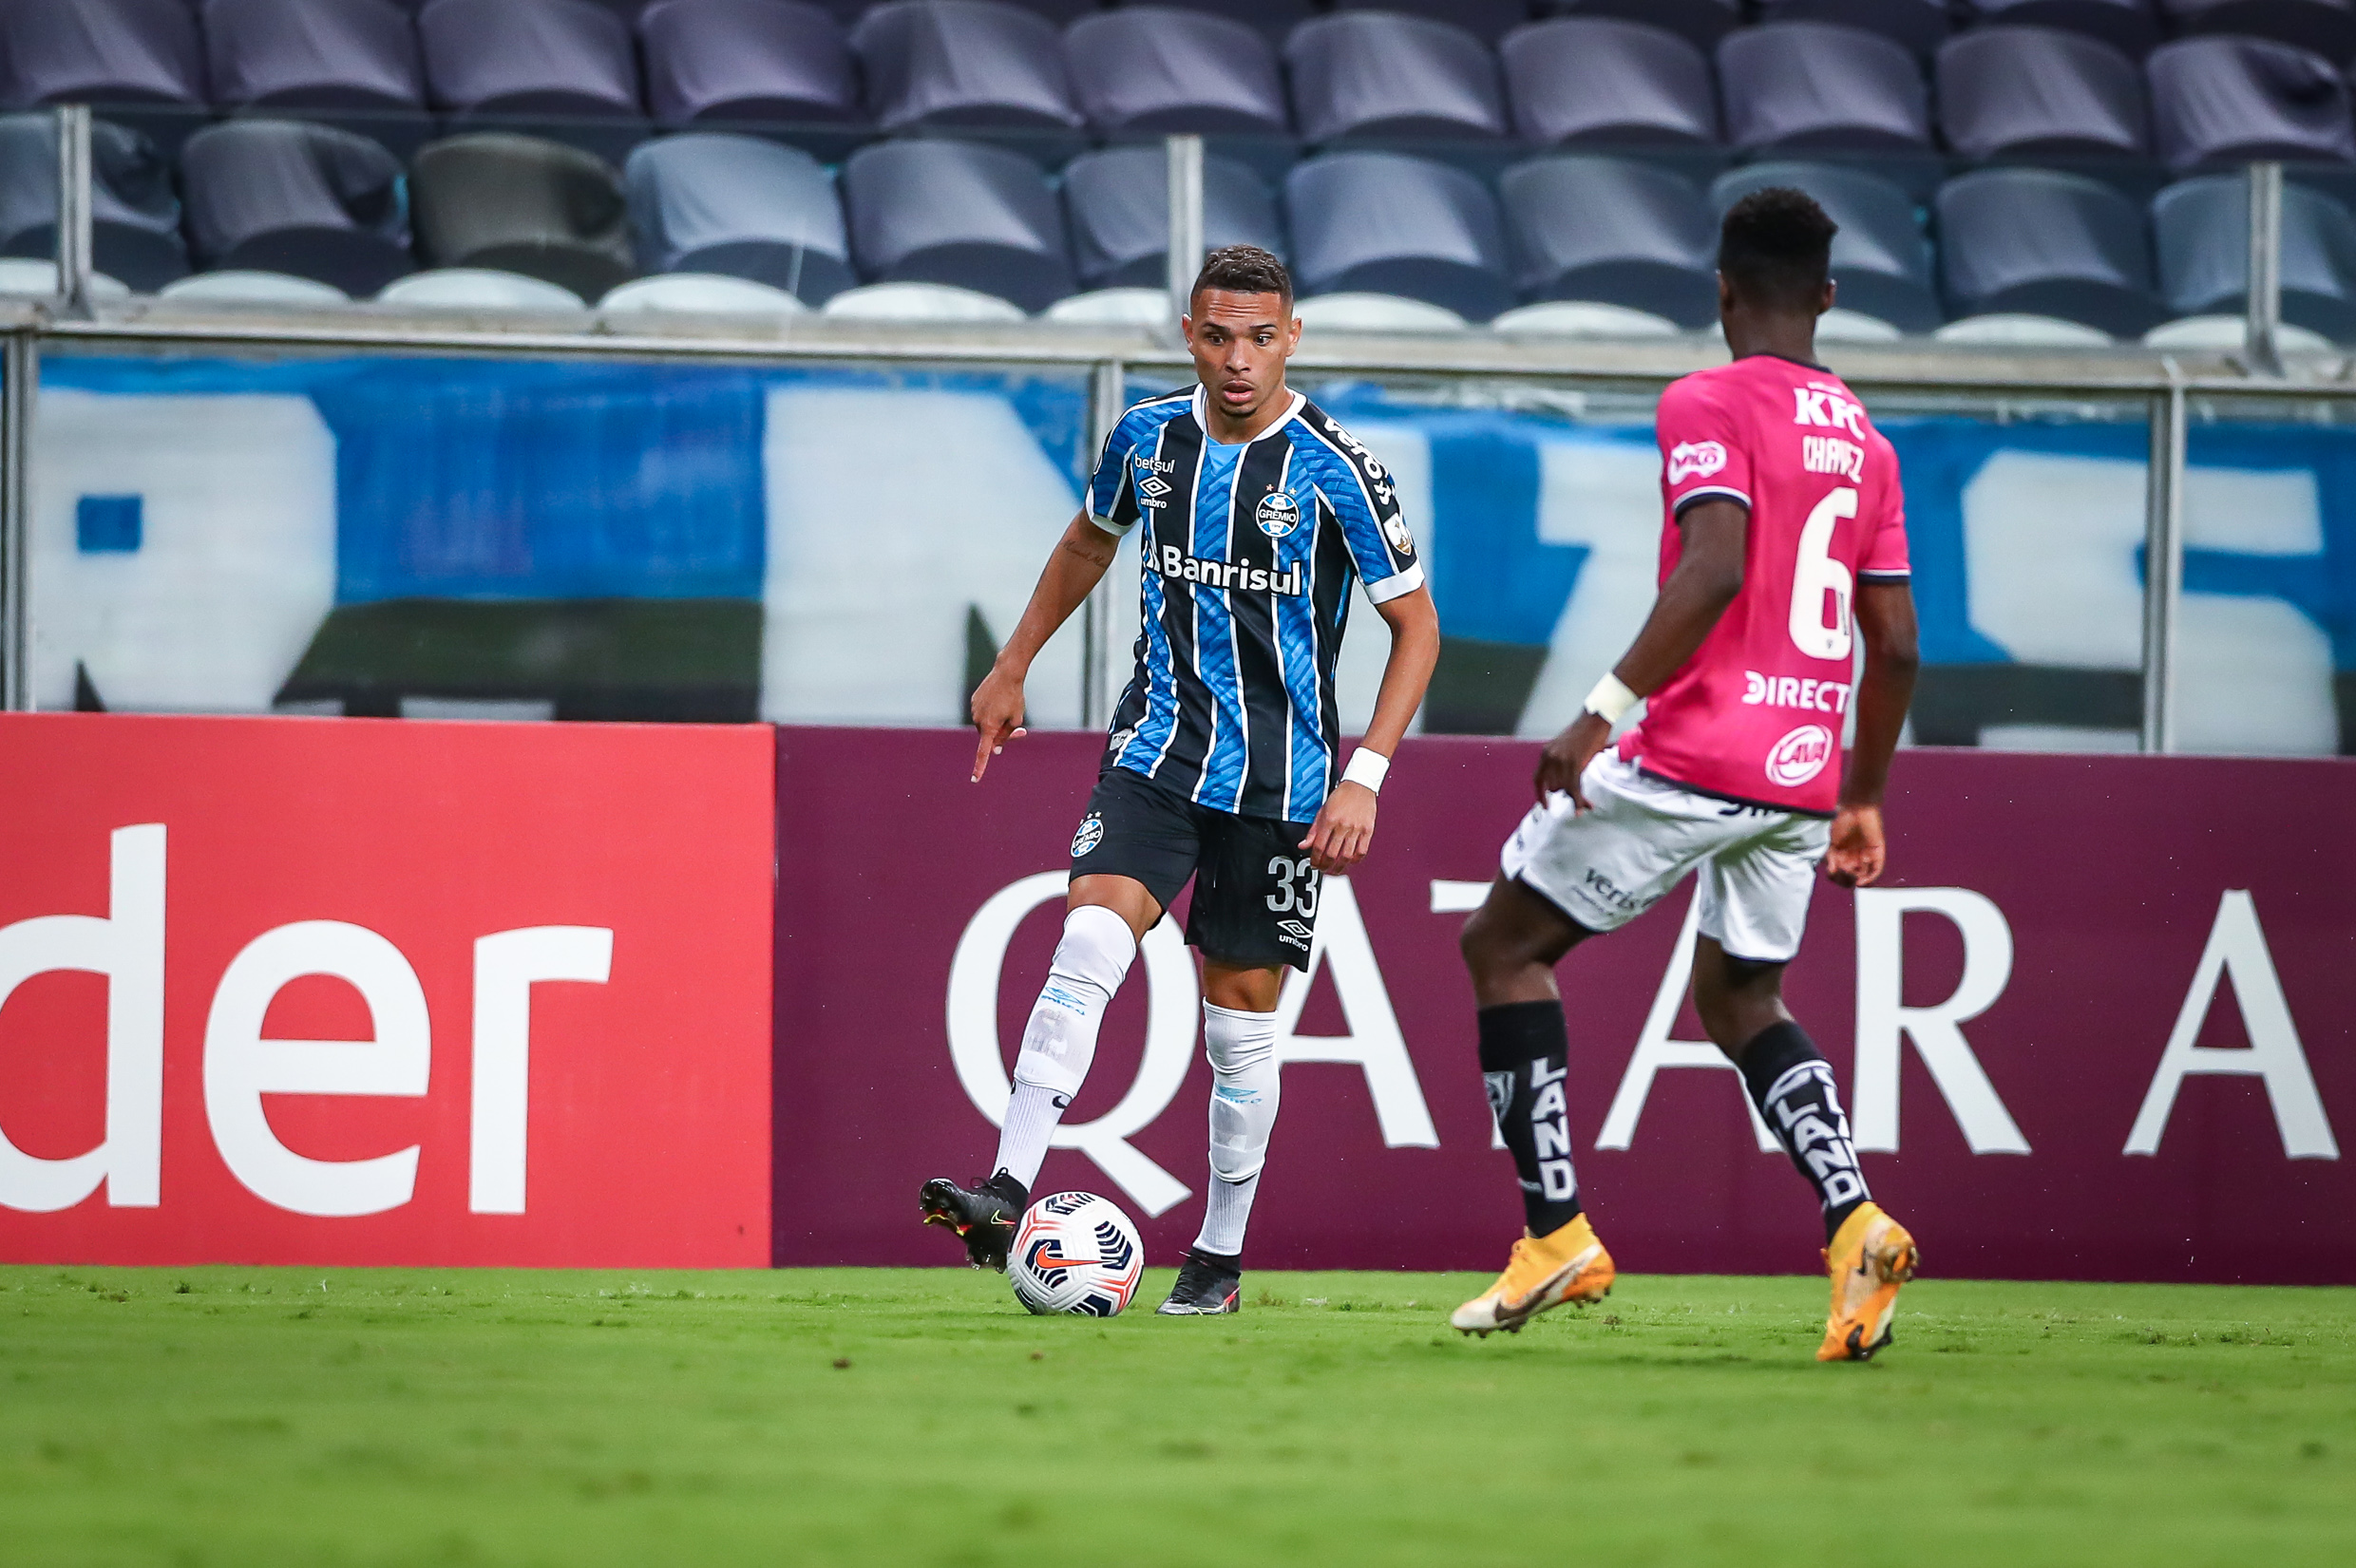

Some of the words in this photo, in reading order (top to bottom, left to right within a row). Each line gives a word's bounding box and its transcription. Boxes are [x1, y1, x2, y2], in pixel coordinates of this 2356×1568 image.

[1792, 387, 1866, 442] KFC
[1134, 452, 1176, 474] betsul
[1140, 497, 1168, 509] umbro
[1162, 544, 1301, 596] Banrisul
[1788, 486, 1858, 661] 6
[1266, 855, 1319, 918] 33
[1279, 935, 1309, 953] umbro
[0, 822, 615, 1218] der
[944, 870, 2033, 1219] QAAR
[2121, 887, 2342, 1160] A
[1530, 1056, 1577, 1202] LAND
[1775, 1097, 1862, 1209] LAND
